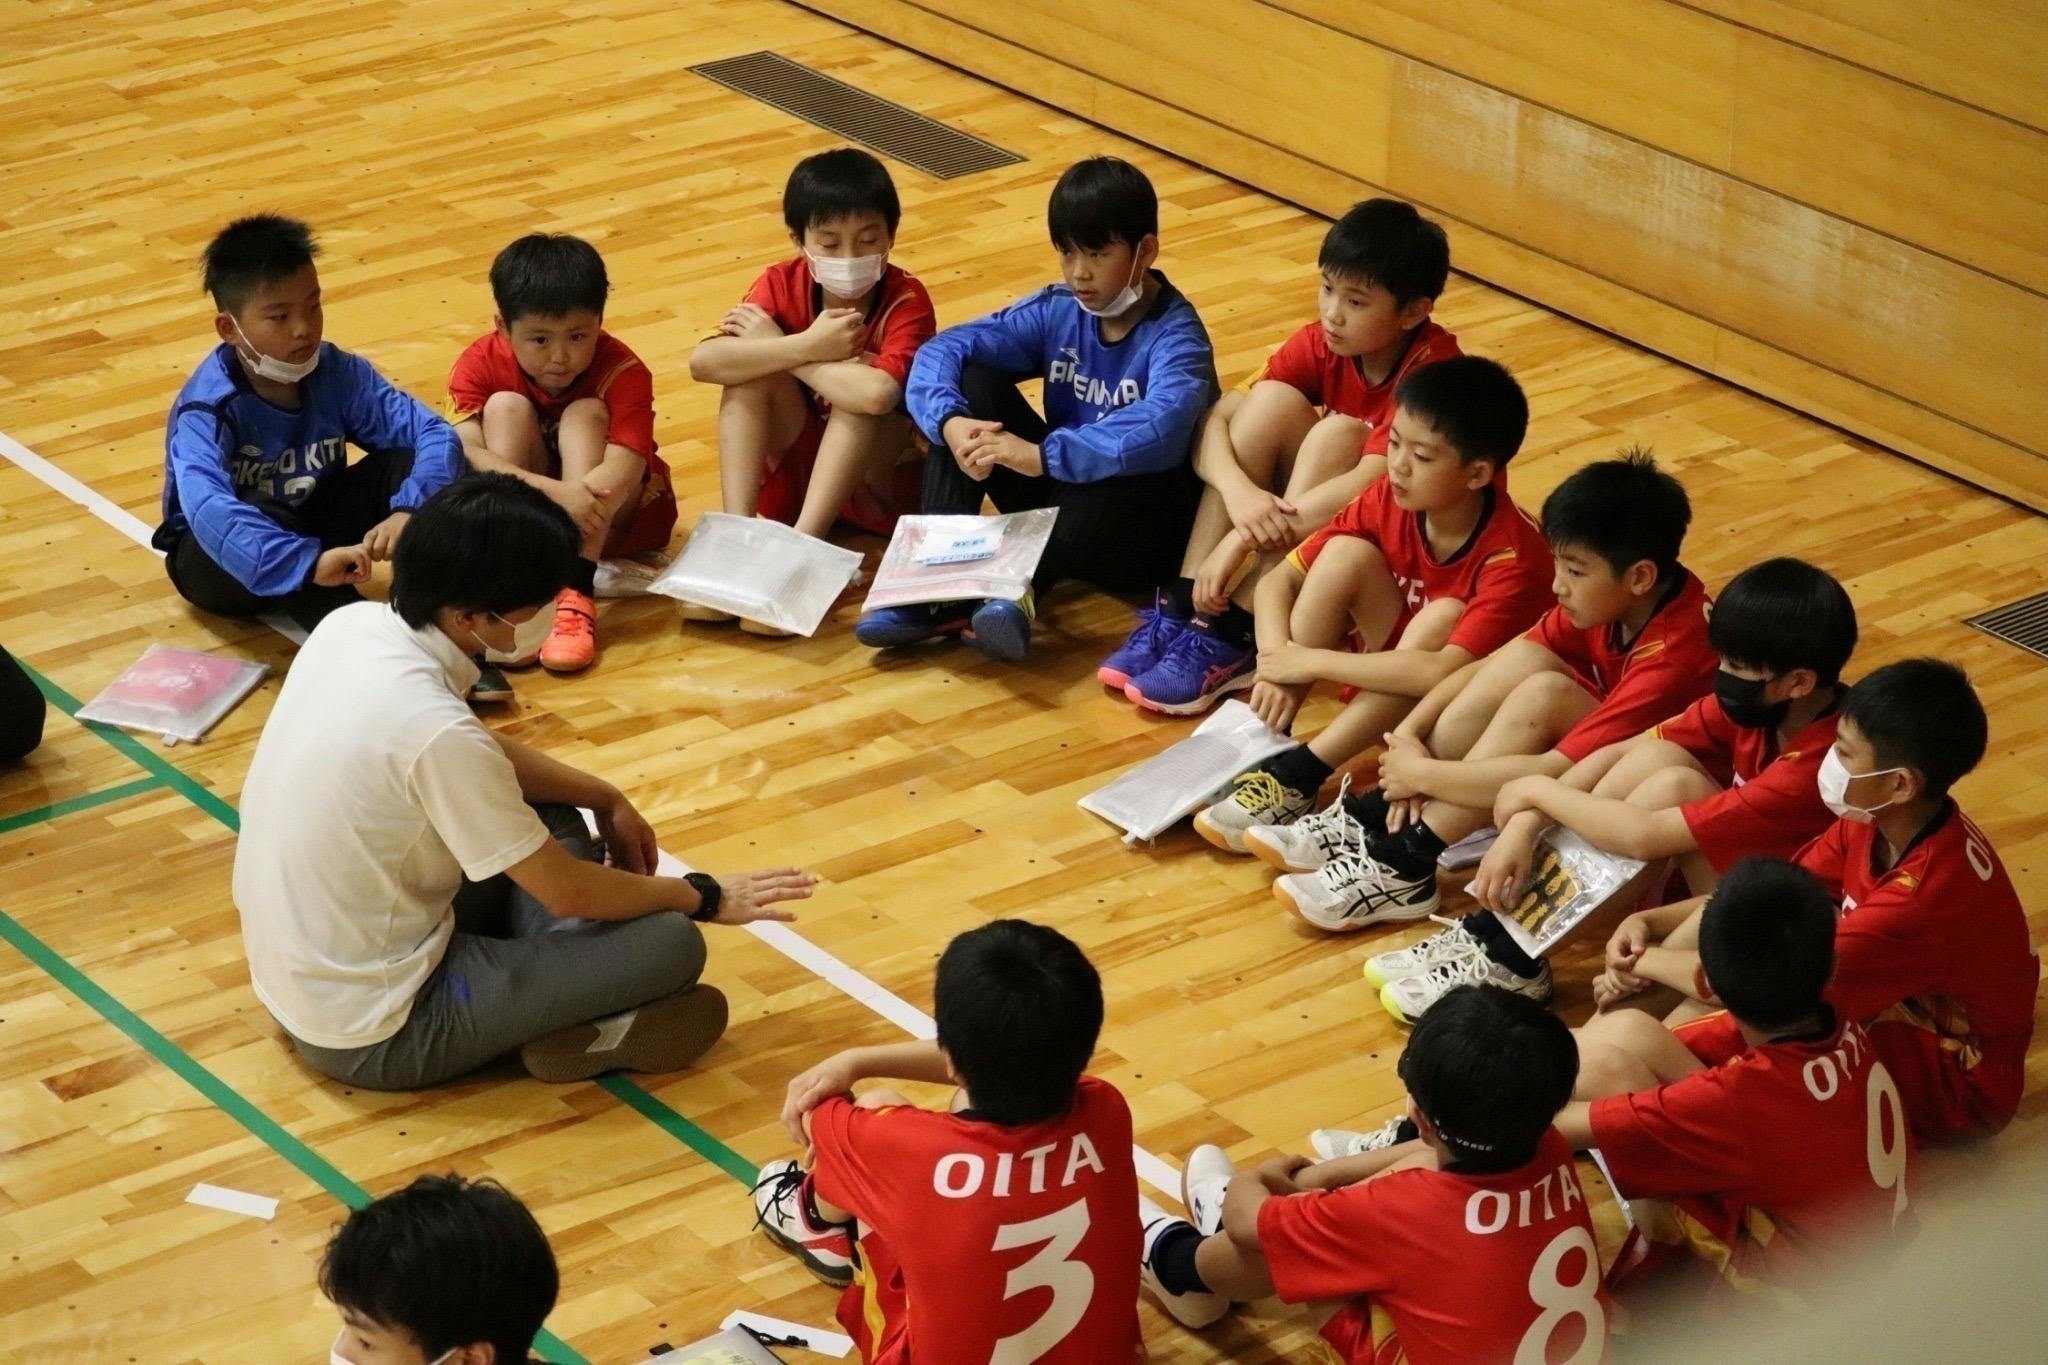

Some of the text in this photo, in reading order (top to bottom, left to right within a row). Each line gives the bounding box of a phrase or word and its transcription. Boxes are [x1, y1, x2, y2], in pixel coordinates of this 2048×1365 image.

[933, 1132, 1106, 1199] OITA
[1465, 1164, 1581, 1235] OITA
[1866, 1061, 1909, 1232] 9
[988, 1196, 1095, 1365] 3
[1513, 1225, 1606, 1365] 8
